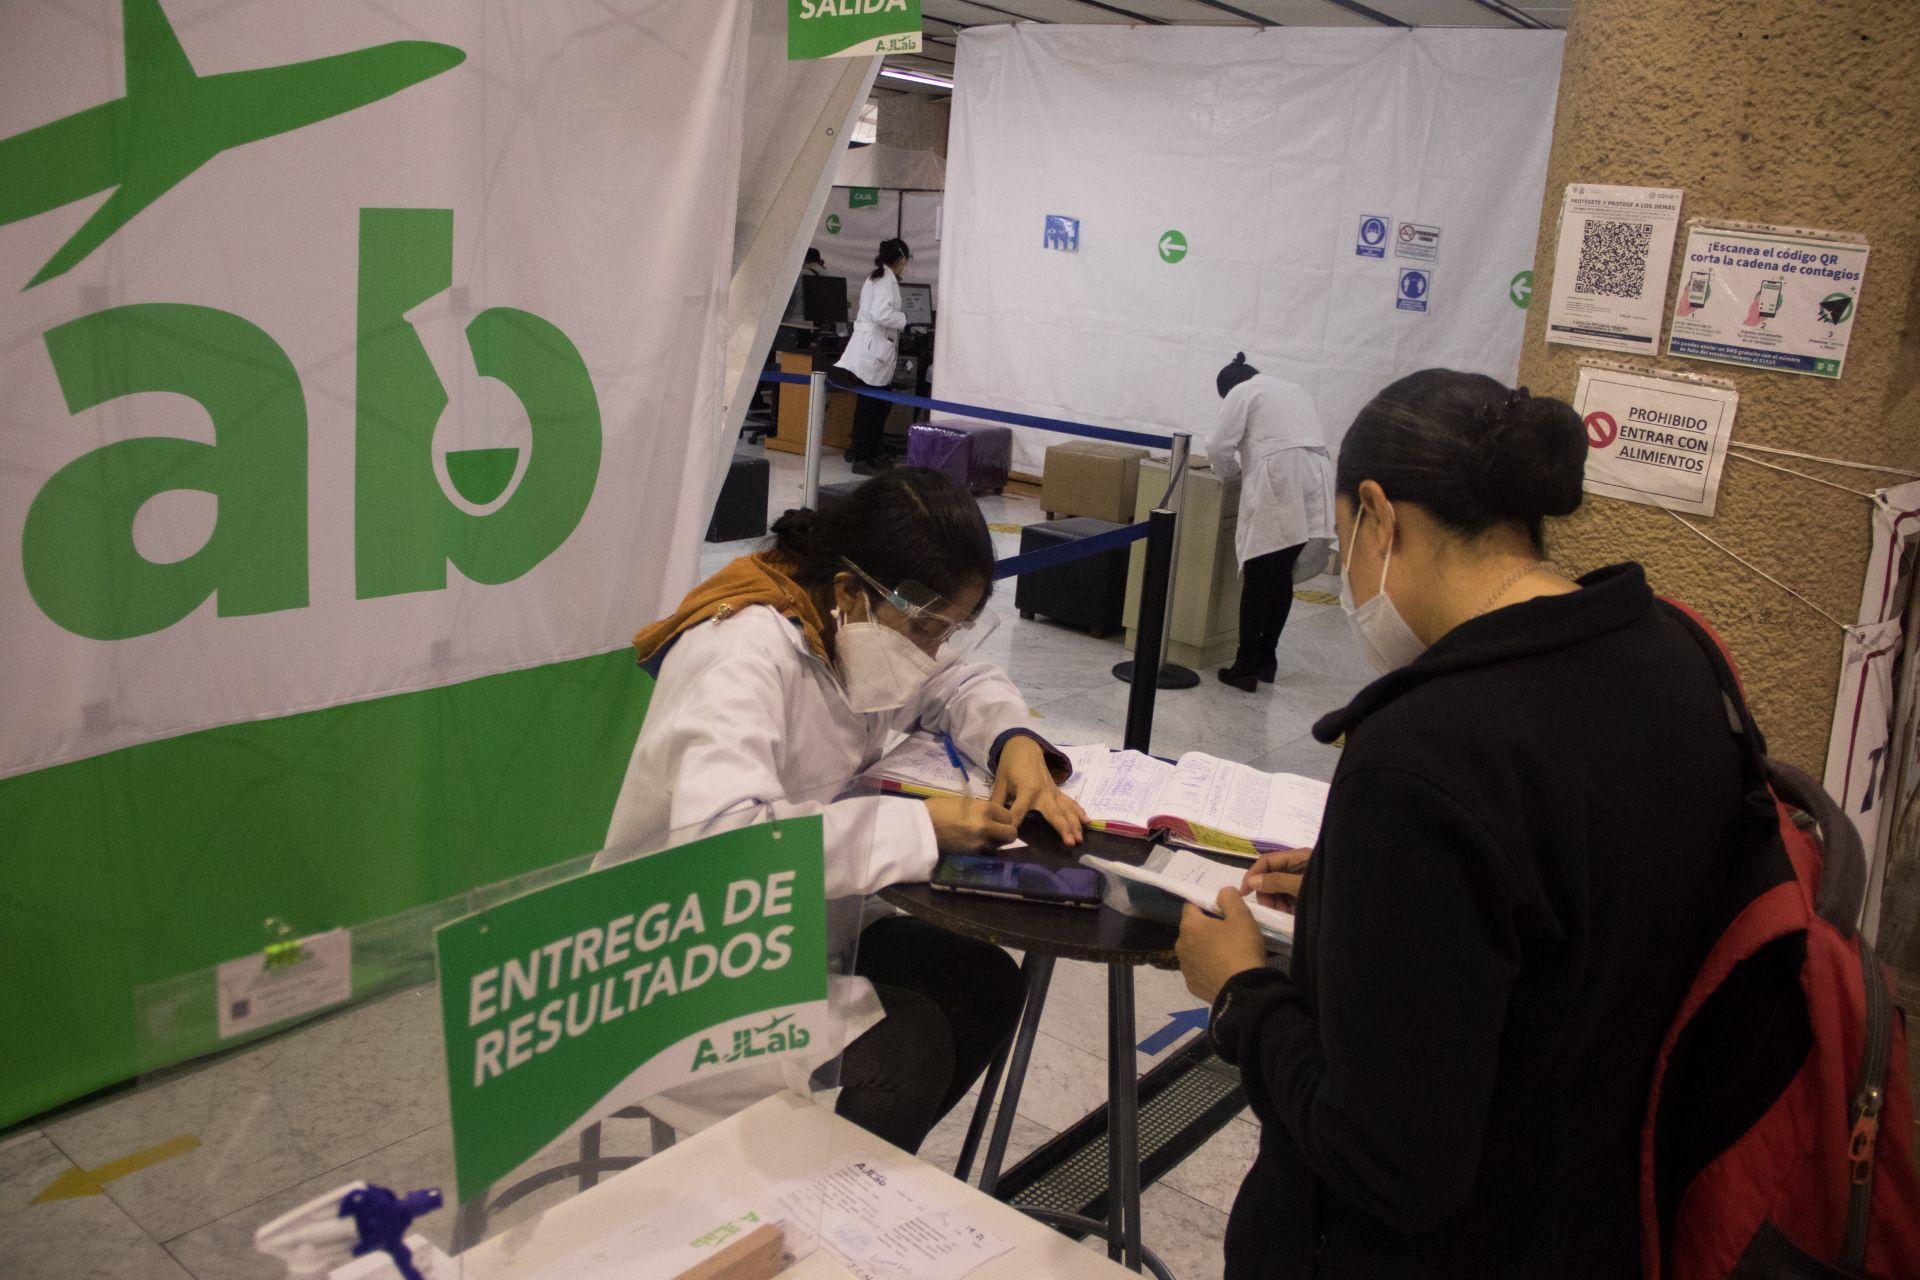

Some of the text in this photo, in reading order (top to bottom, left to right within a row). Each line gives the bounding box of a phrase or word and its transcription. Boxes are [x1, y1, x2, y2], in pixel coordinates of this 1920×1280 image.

[1690, 252, 1860, 281] corta la cadena de contagios
[1708, 241, 1838, 266] ¡Escanea el código QR
[1629, 406, 1708, 431] PROHIBIDO
[1620, 425, 1709, 452] ENTRAR CON
[1619, 445, 1704, 472] ALIMIENTOS
[468, 870, 796, 1027] ENTREGA DE
[473, 925, 794, 1088] RESULTADOS
[691, 1023, 810, 1072] AJLab
